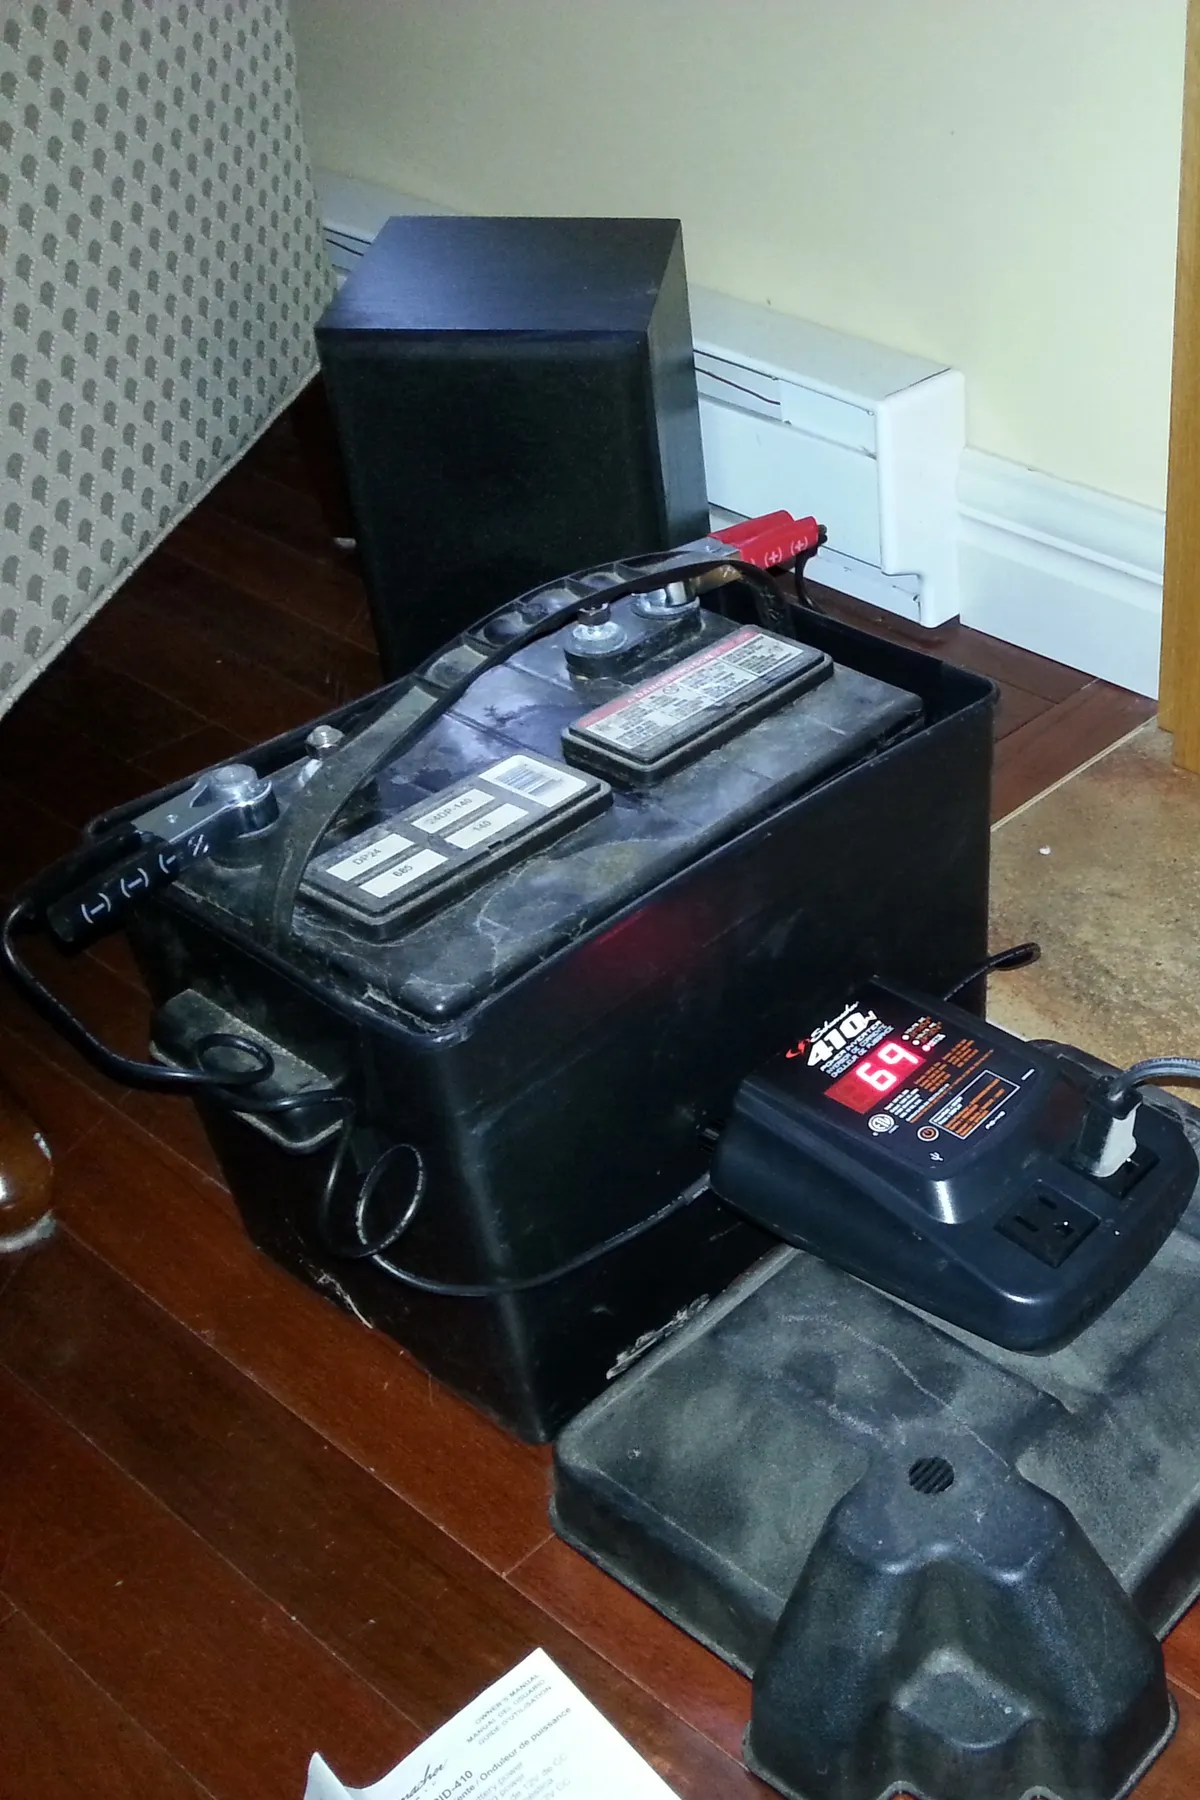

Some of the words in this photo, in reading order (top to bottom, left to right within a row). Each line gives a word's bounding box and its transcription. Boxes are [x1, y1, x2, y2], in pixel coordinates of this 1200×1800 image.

[472, 820, 492, 832] 140
[352, 847, 382, 866] DP24
[820, 1048, 847, 1072] POWER
[845, 1020, 882, 1050] INVERTER
[855, 1042, 919, 1092] 69
[475, 1696, 509, 1725] OWNER'S
[509, 1674, 540, 1697] MANUAL
[466, 1717, 496, 1743] MANUAL
[480, 1748, 518, 1781] Onduleur
[518, 1739, 530, 1750] de
[530, 1707, 572, 1741] puissance
